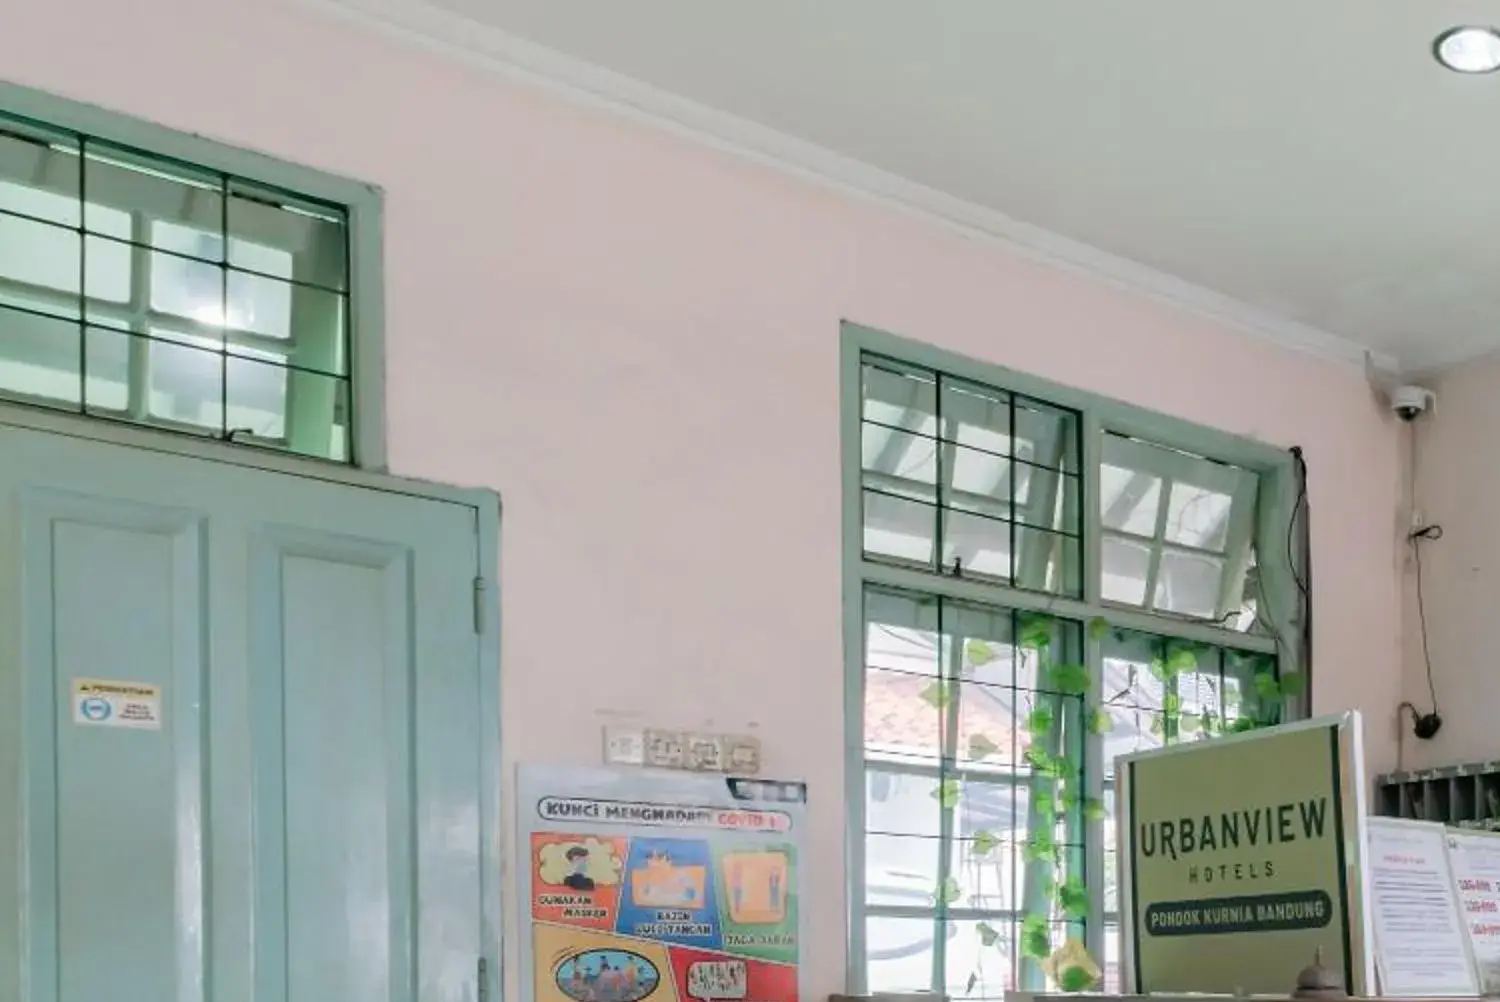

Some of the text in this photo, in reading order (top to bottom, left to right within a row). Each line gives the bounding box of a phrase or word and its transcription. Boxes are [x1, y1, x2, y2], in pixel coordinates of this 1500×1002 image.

[546, 801, 599, 817] KUNCI
[1141, 797, 1326, 861] URBANVIEW
[1189, 861, 1274, 884] HOTELS
[1152, 901, 1324, 927] PONDOK KURNIA BANDUNG
